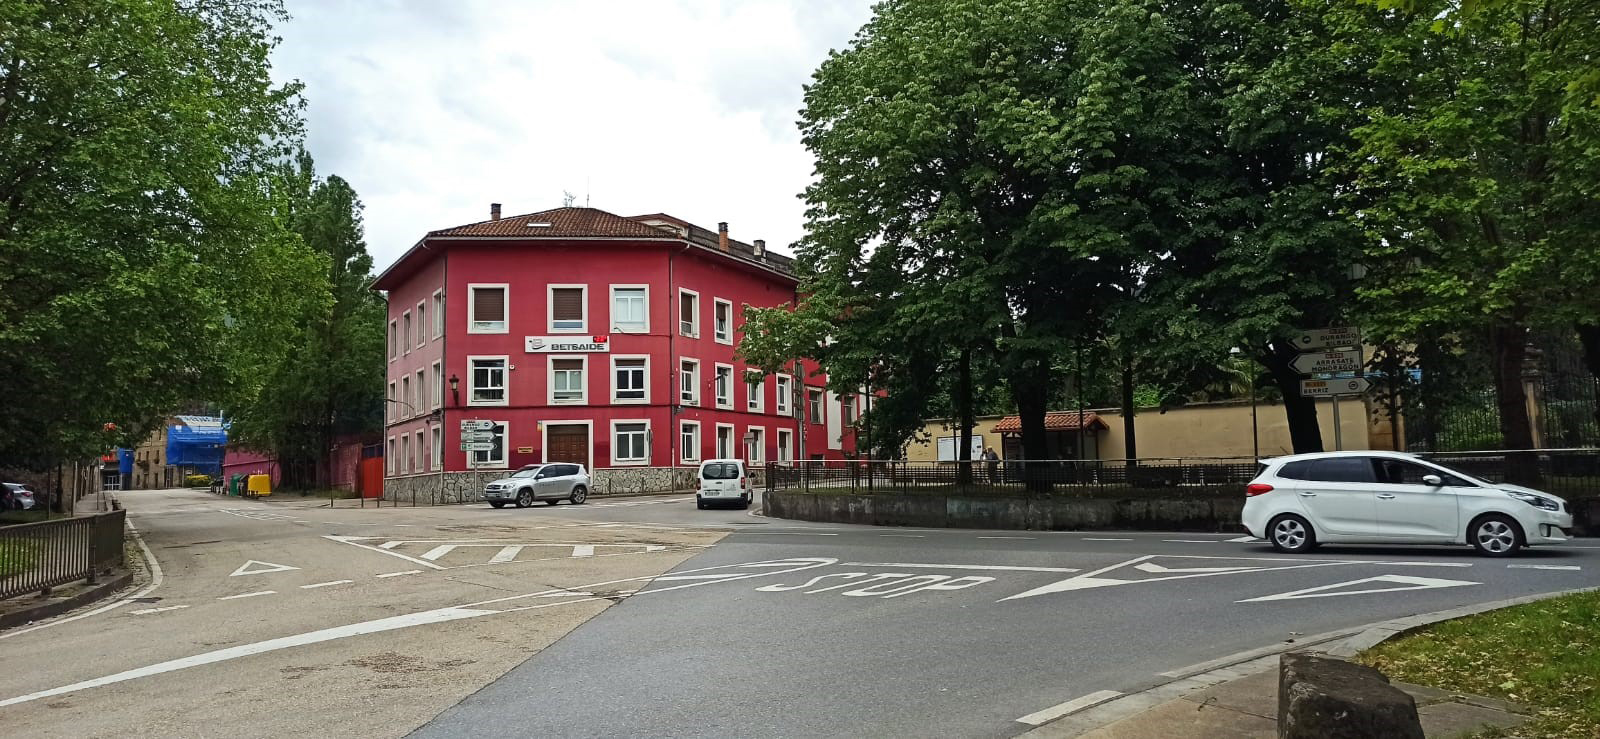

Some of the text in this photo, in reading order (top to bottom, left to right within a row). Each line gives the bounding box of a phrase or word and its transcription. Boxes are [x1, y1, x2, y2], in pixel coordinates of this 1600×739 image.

[1320, 333, 1357, 341] DURANGO
[551, 343, 605, 351] BETSAIDE
[1316, 358, 1354, 366] ARRASATE
[755, 572, 997, 599] STOP
